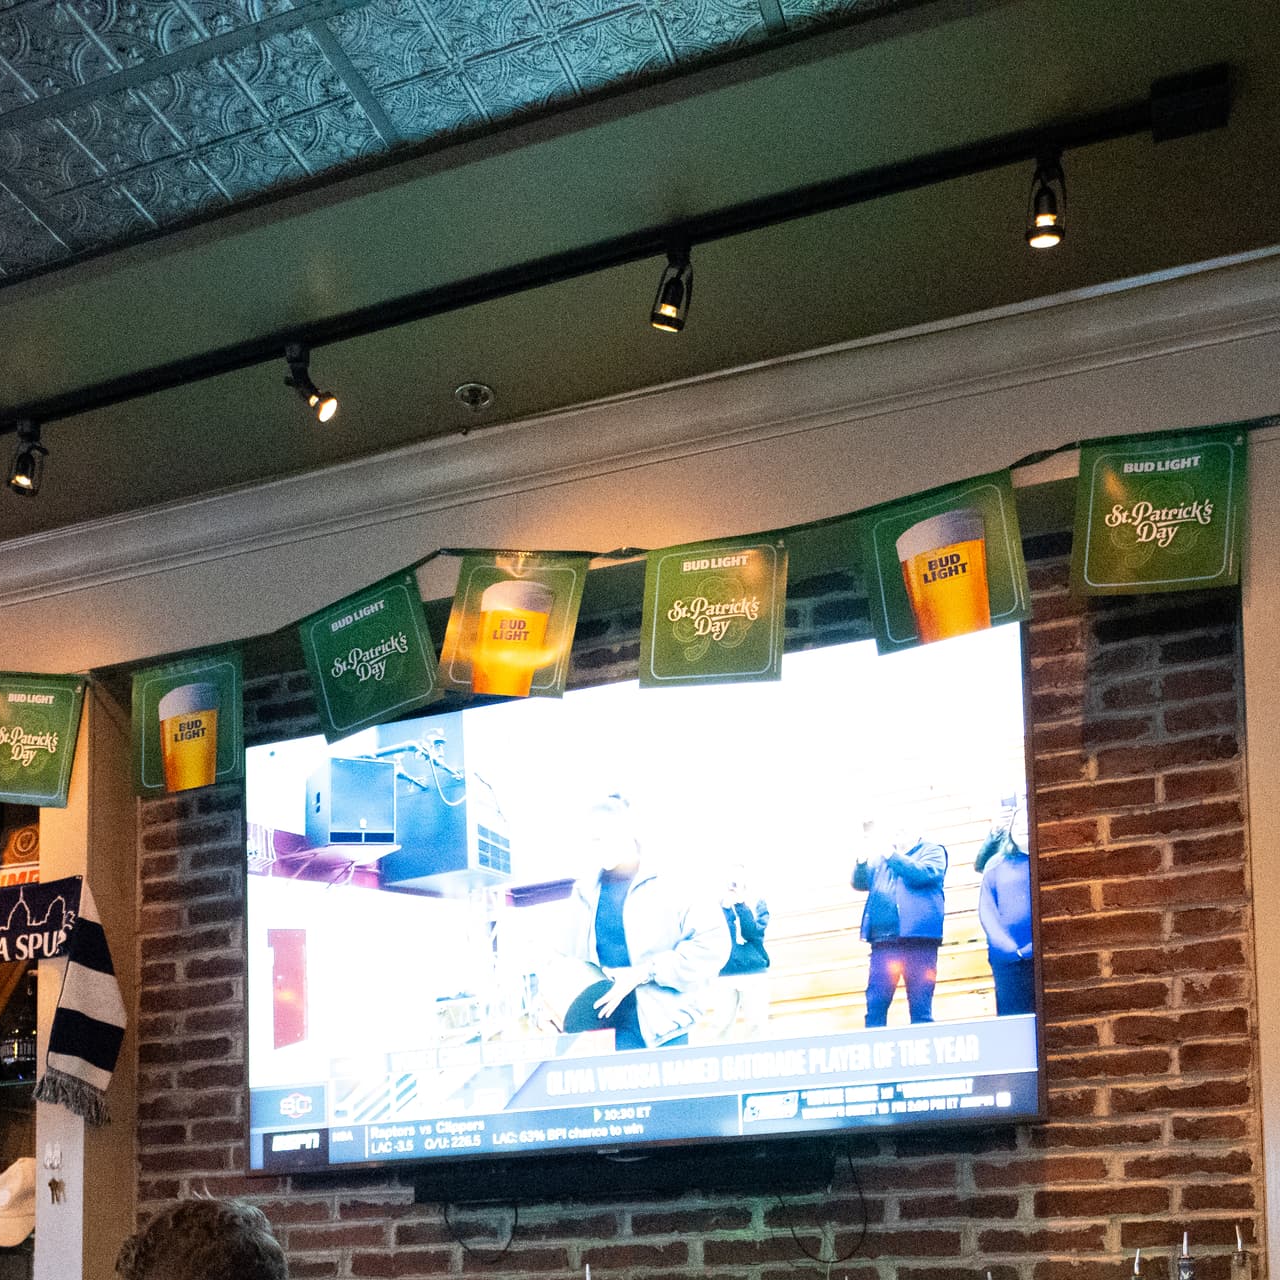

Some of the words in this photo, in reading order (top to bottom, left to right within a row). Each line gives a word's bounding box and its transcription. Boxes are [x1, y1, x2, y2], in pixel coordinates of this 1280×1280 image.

[1123, 459, 1154, 474] BUD
[1155, 456, 1201, 472] LIGHT
[1105, 502, 1133, 528] St.
[1129, 499, 1214, 527] Patrick's
[1136, 522, 1178, 548] Day
[682, 557, 709, 571] BUD
[710, 555, 748, 569] LIGHT
[927, 552, 961, 573] BUD
[922, 563, 969, 585] LIGHT
[331, 614, 353, 633] BUD
[354, 600, 385, 623] LIGHT
[668, 598, 693, 623] St.
[690, 597, 760, 622] Patrick's
[493, 629, 529, 642] LIGHT
[500, 619, 526, 631] BUD
[694, 615, 731, 641] Day
[331, 657, 352, 679] St.
[349, 632, 409, 672] Patrick's
[357, 659, 387, 683] Day
[8, 693, 28, 704] BUD
[29, 694, 55, 705] LIGHT
[174, 728, 206, 742] LIGHT
[179, 720, 202, 731] BUD
[10, 728, 58, 752] Patrick's
[11, 743, 36, 766] Day
[662, 1058, 720, 1087] NAMED
[722, 1051, 807, 1081] GATORADE
[809, 1045, 871, 1075] PLAYER
[873, 1040, 898, 1069] OF
[900, 1038, 931, 1066] THE
[933, 1034, 980, 1063] YEAR
[370, 1124, 416, 1141] Raptors
[420, 1125, 432, 1135] vs
[436, 1119, 485, 1137] Clippers
[519, 1131, 545, 1143] 63%
[568, 1127, 609, 1140] chance
[610, 1126, 622, 1137] to
[623, 1124, 644, 1135] win
[371, 1142, 391, 1153] LAC
